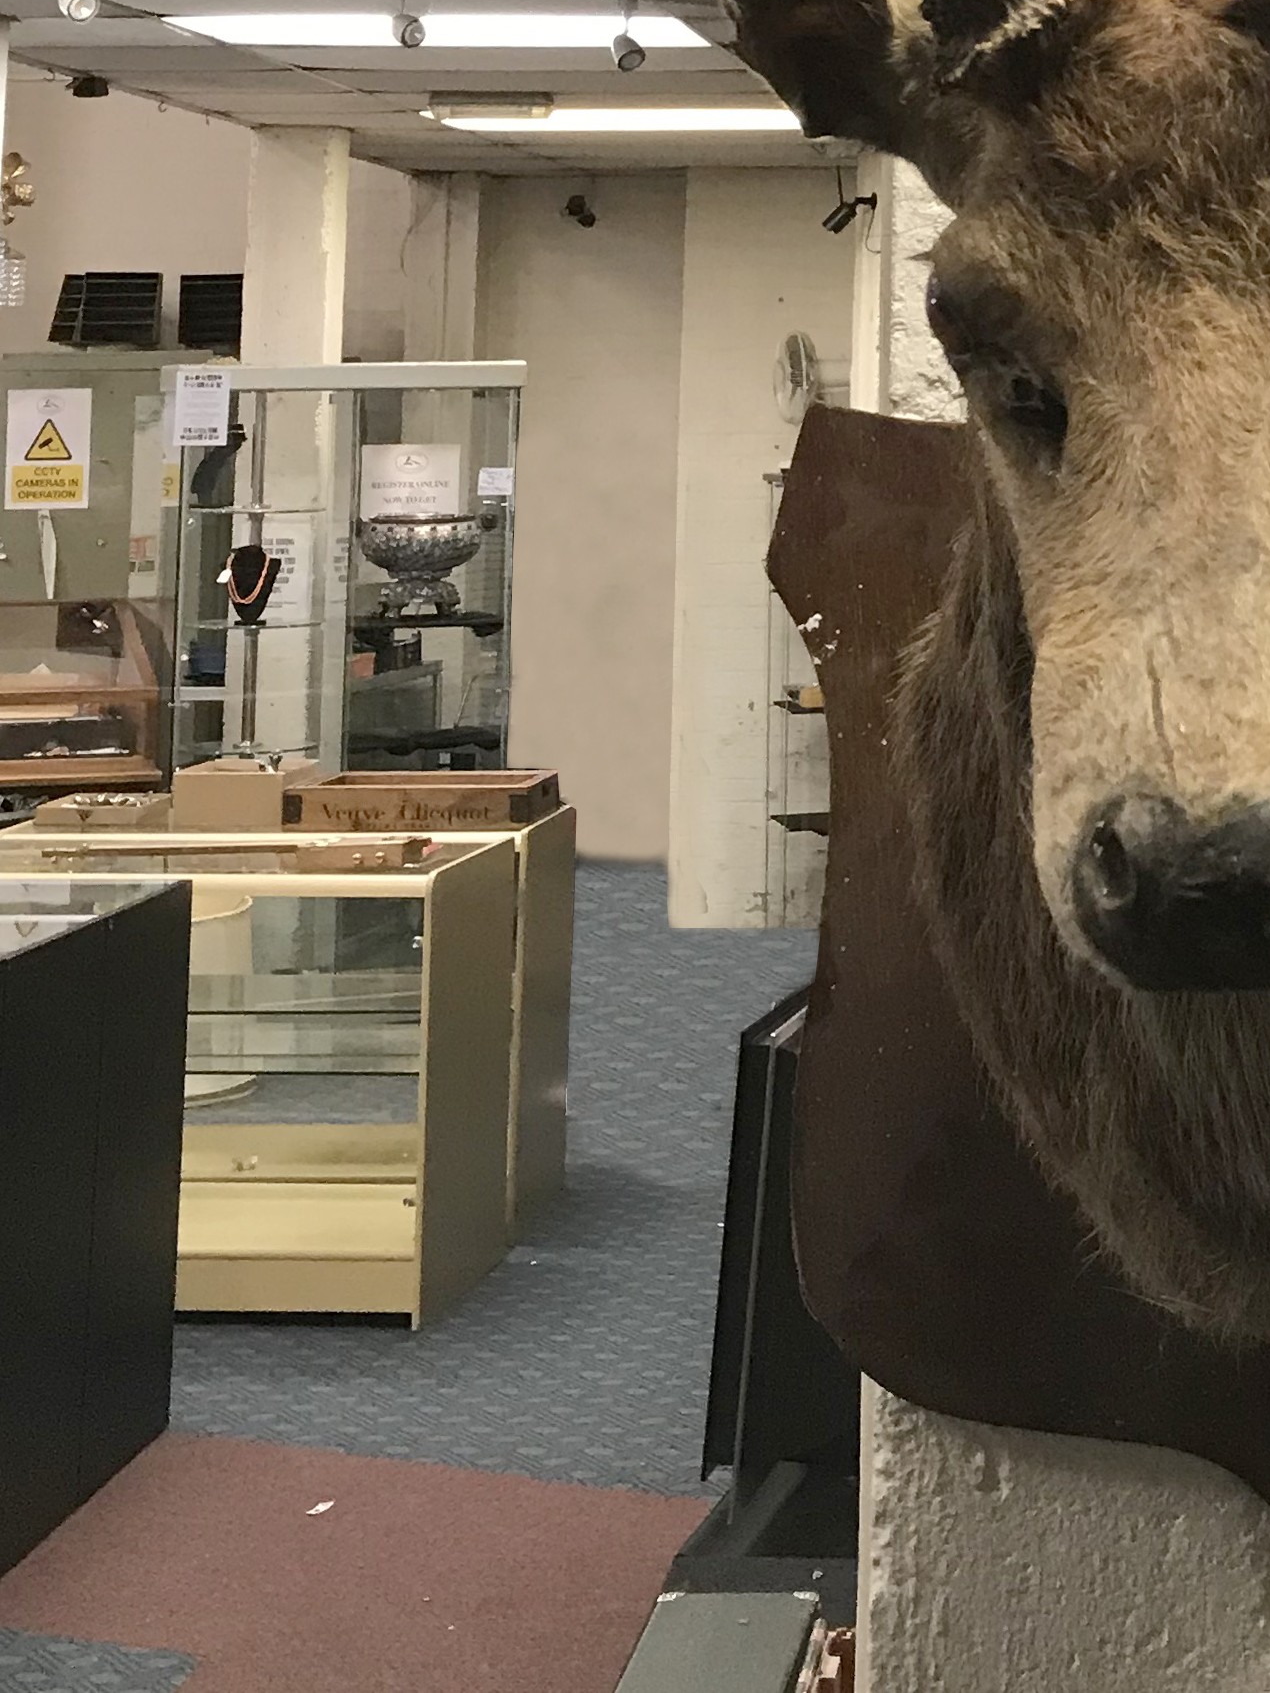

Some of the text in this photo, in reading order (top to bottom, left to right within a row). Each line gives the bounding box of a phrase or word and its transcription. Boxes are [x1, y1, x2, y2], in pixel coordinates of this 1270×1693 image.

[33, 466, 62, 476] CCTV
[15, 478, 79, 488] CAMERAS IN
[371, 480, 415, 489] REGISTER
[18, 490, 77, 499] OPERATION
[321, 800, 491, 826] Veuve Clicquot
